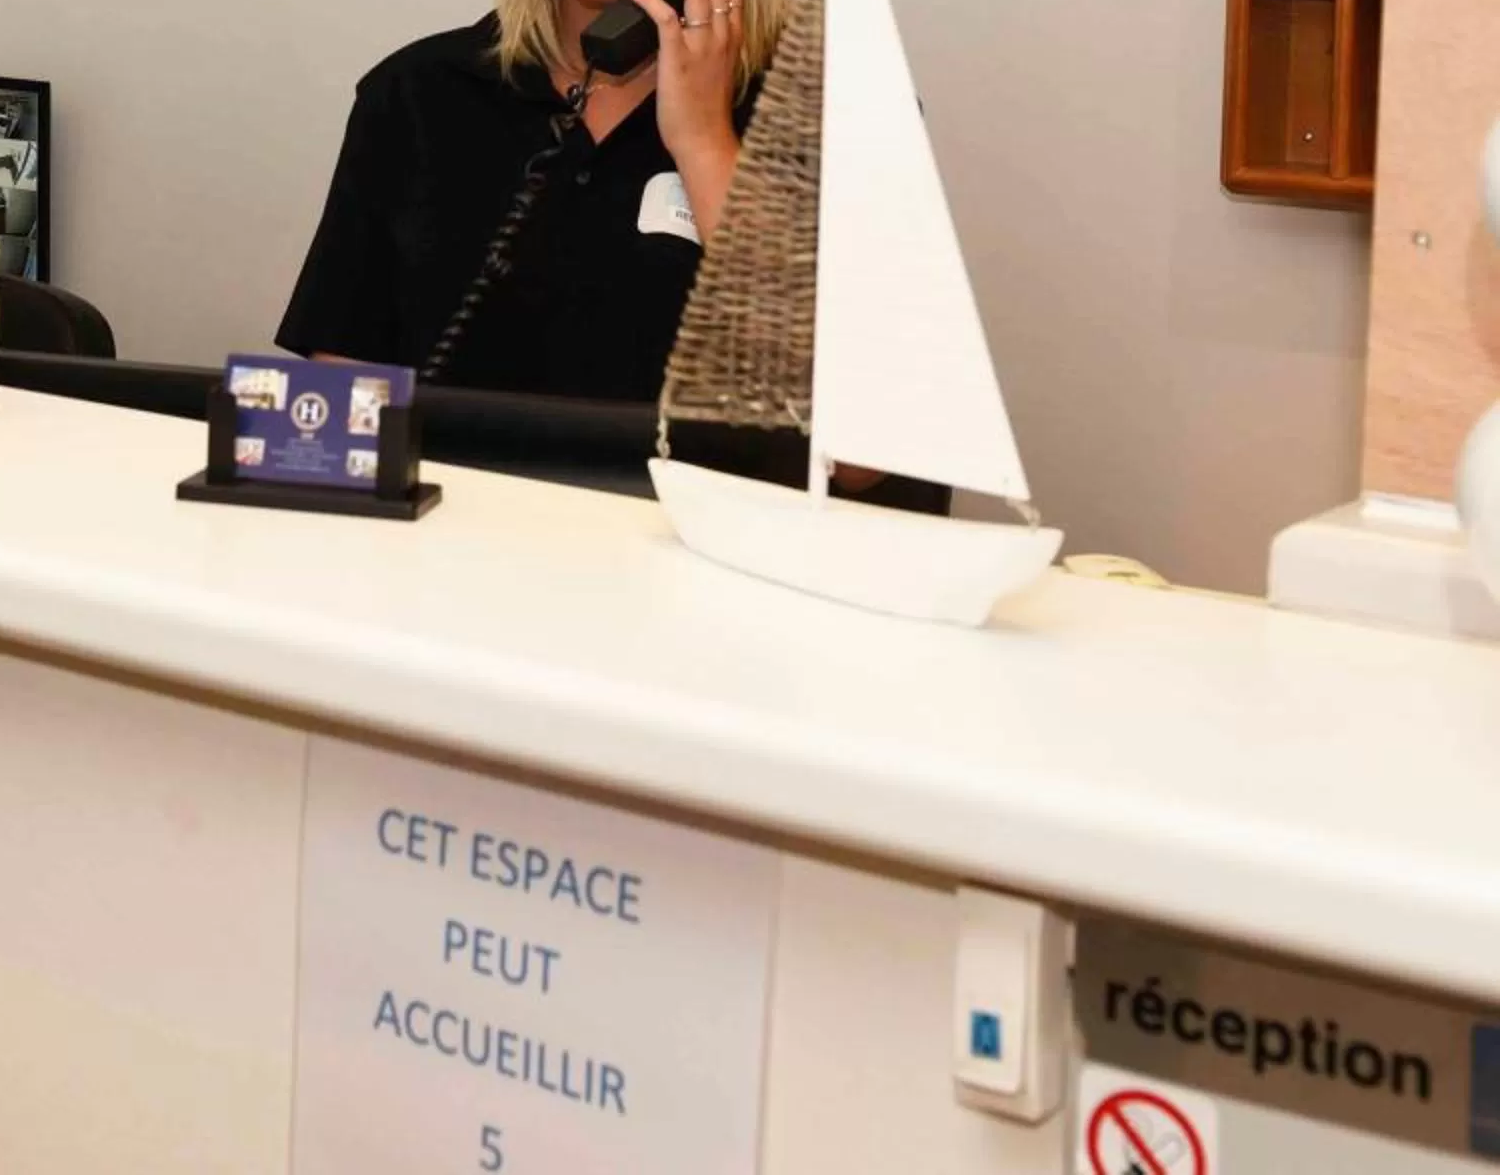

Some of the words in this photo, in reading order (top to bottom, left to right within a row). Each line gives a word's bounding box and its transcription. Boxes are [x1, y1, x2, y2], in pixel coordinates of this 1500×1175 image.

[377, 808, 459, 868] CET
[470, 832, 643, 924] ESPACE
[443, 919, 561, 994] PEUT
[373, 990, 627, 1115] ACCUEILLIR
[1103, 975, 1434, 1102] réception
[478, 1124, 504, 1173] 5
